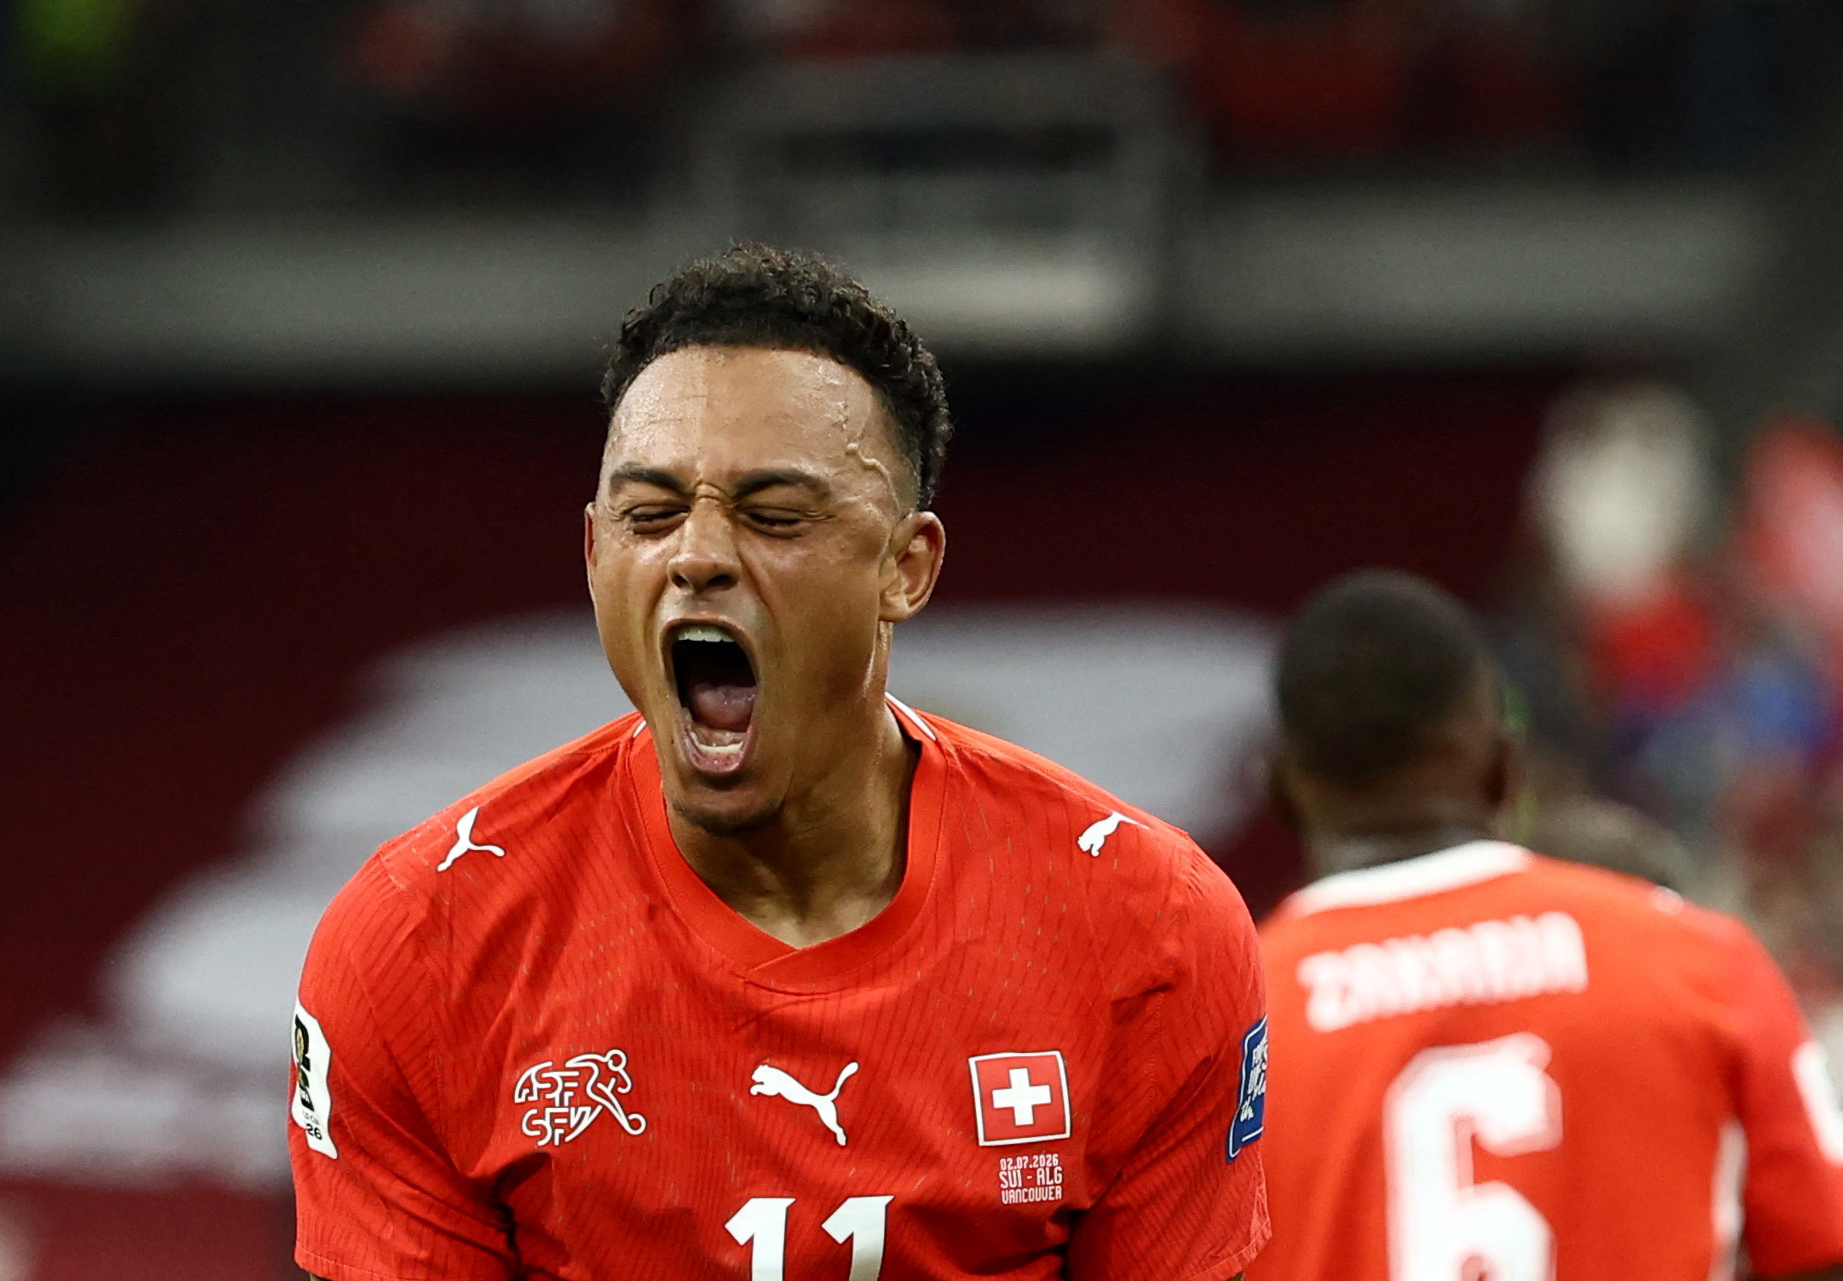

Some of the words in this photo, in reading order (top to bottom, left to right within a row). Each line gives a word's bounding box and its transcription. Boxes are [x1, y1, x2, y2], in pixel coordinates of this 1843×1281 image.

[999, 1153, 1059, 1171] 02.07.2026
[999, 1169, 1022, 1189] SUI
[1036, 1166, 1063, 1186] ALG
[1001, 1186, 1062, 1204] VANCOUVER
